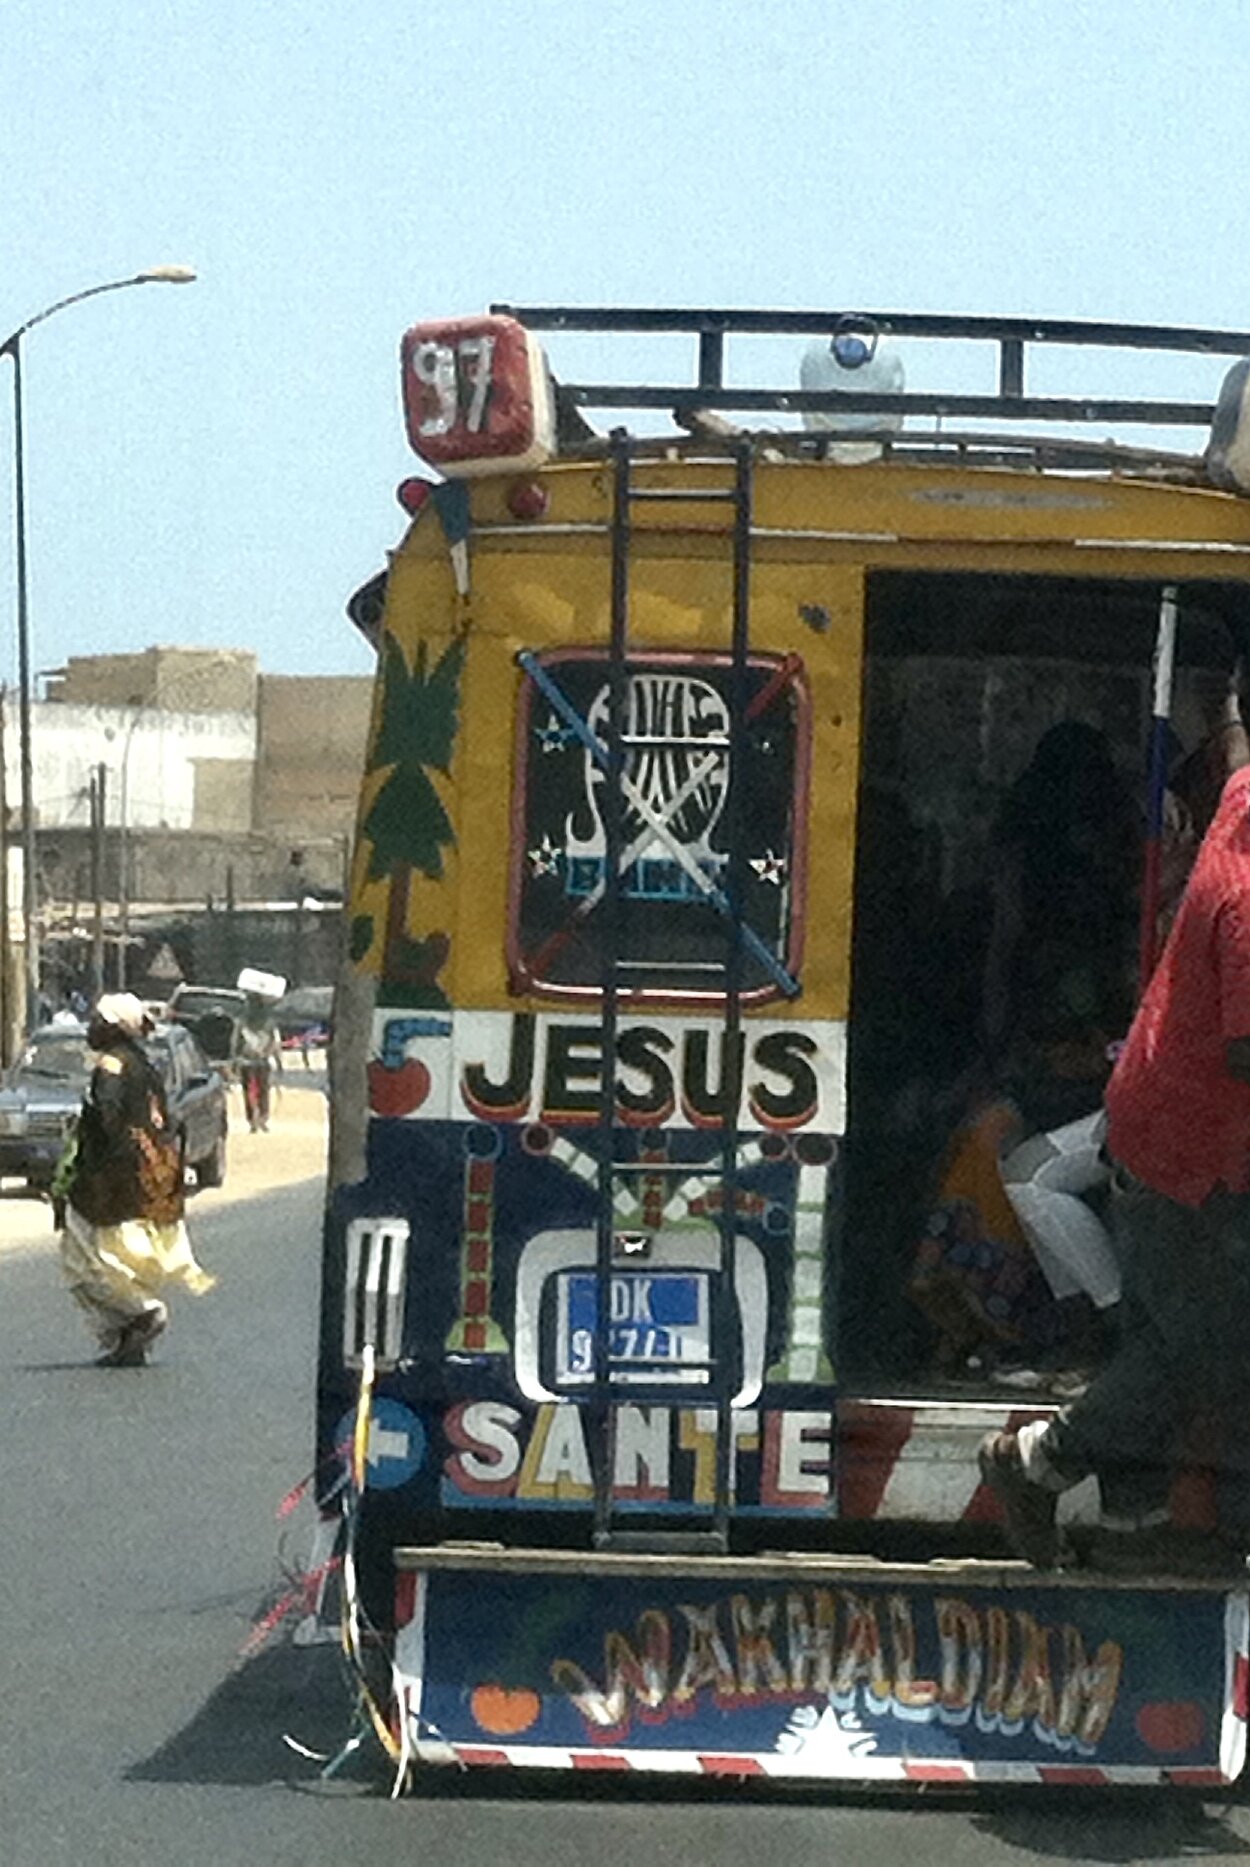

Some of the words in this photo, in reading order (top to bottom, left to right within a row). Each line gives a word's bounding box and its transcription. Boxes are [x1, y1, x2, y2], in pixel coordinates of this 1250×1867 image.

[412, 335, 498, 438] 97
[460, 1012, 818, 1129] JESUS
[610, 1279, 653, 1323] DK
[443, 1400, 832, 1508] SANTE
